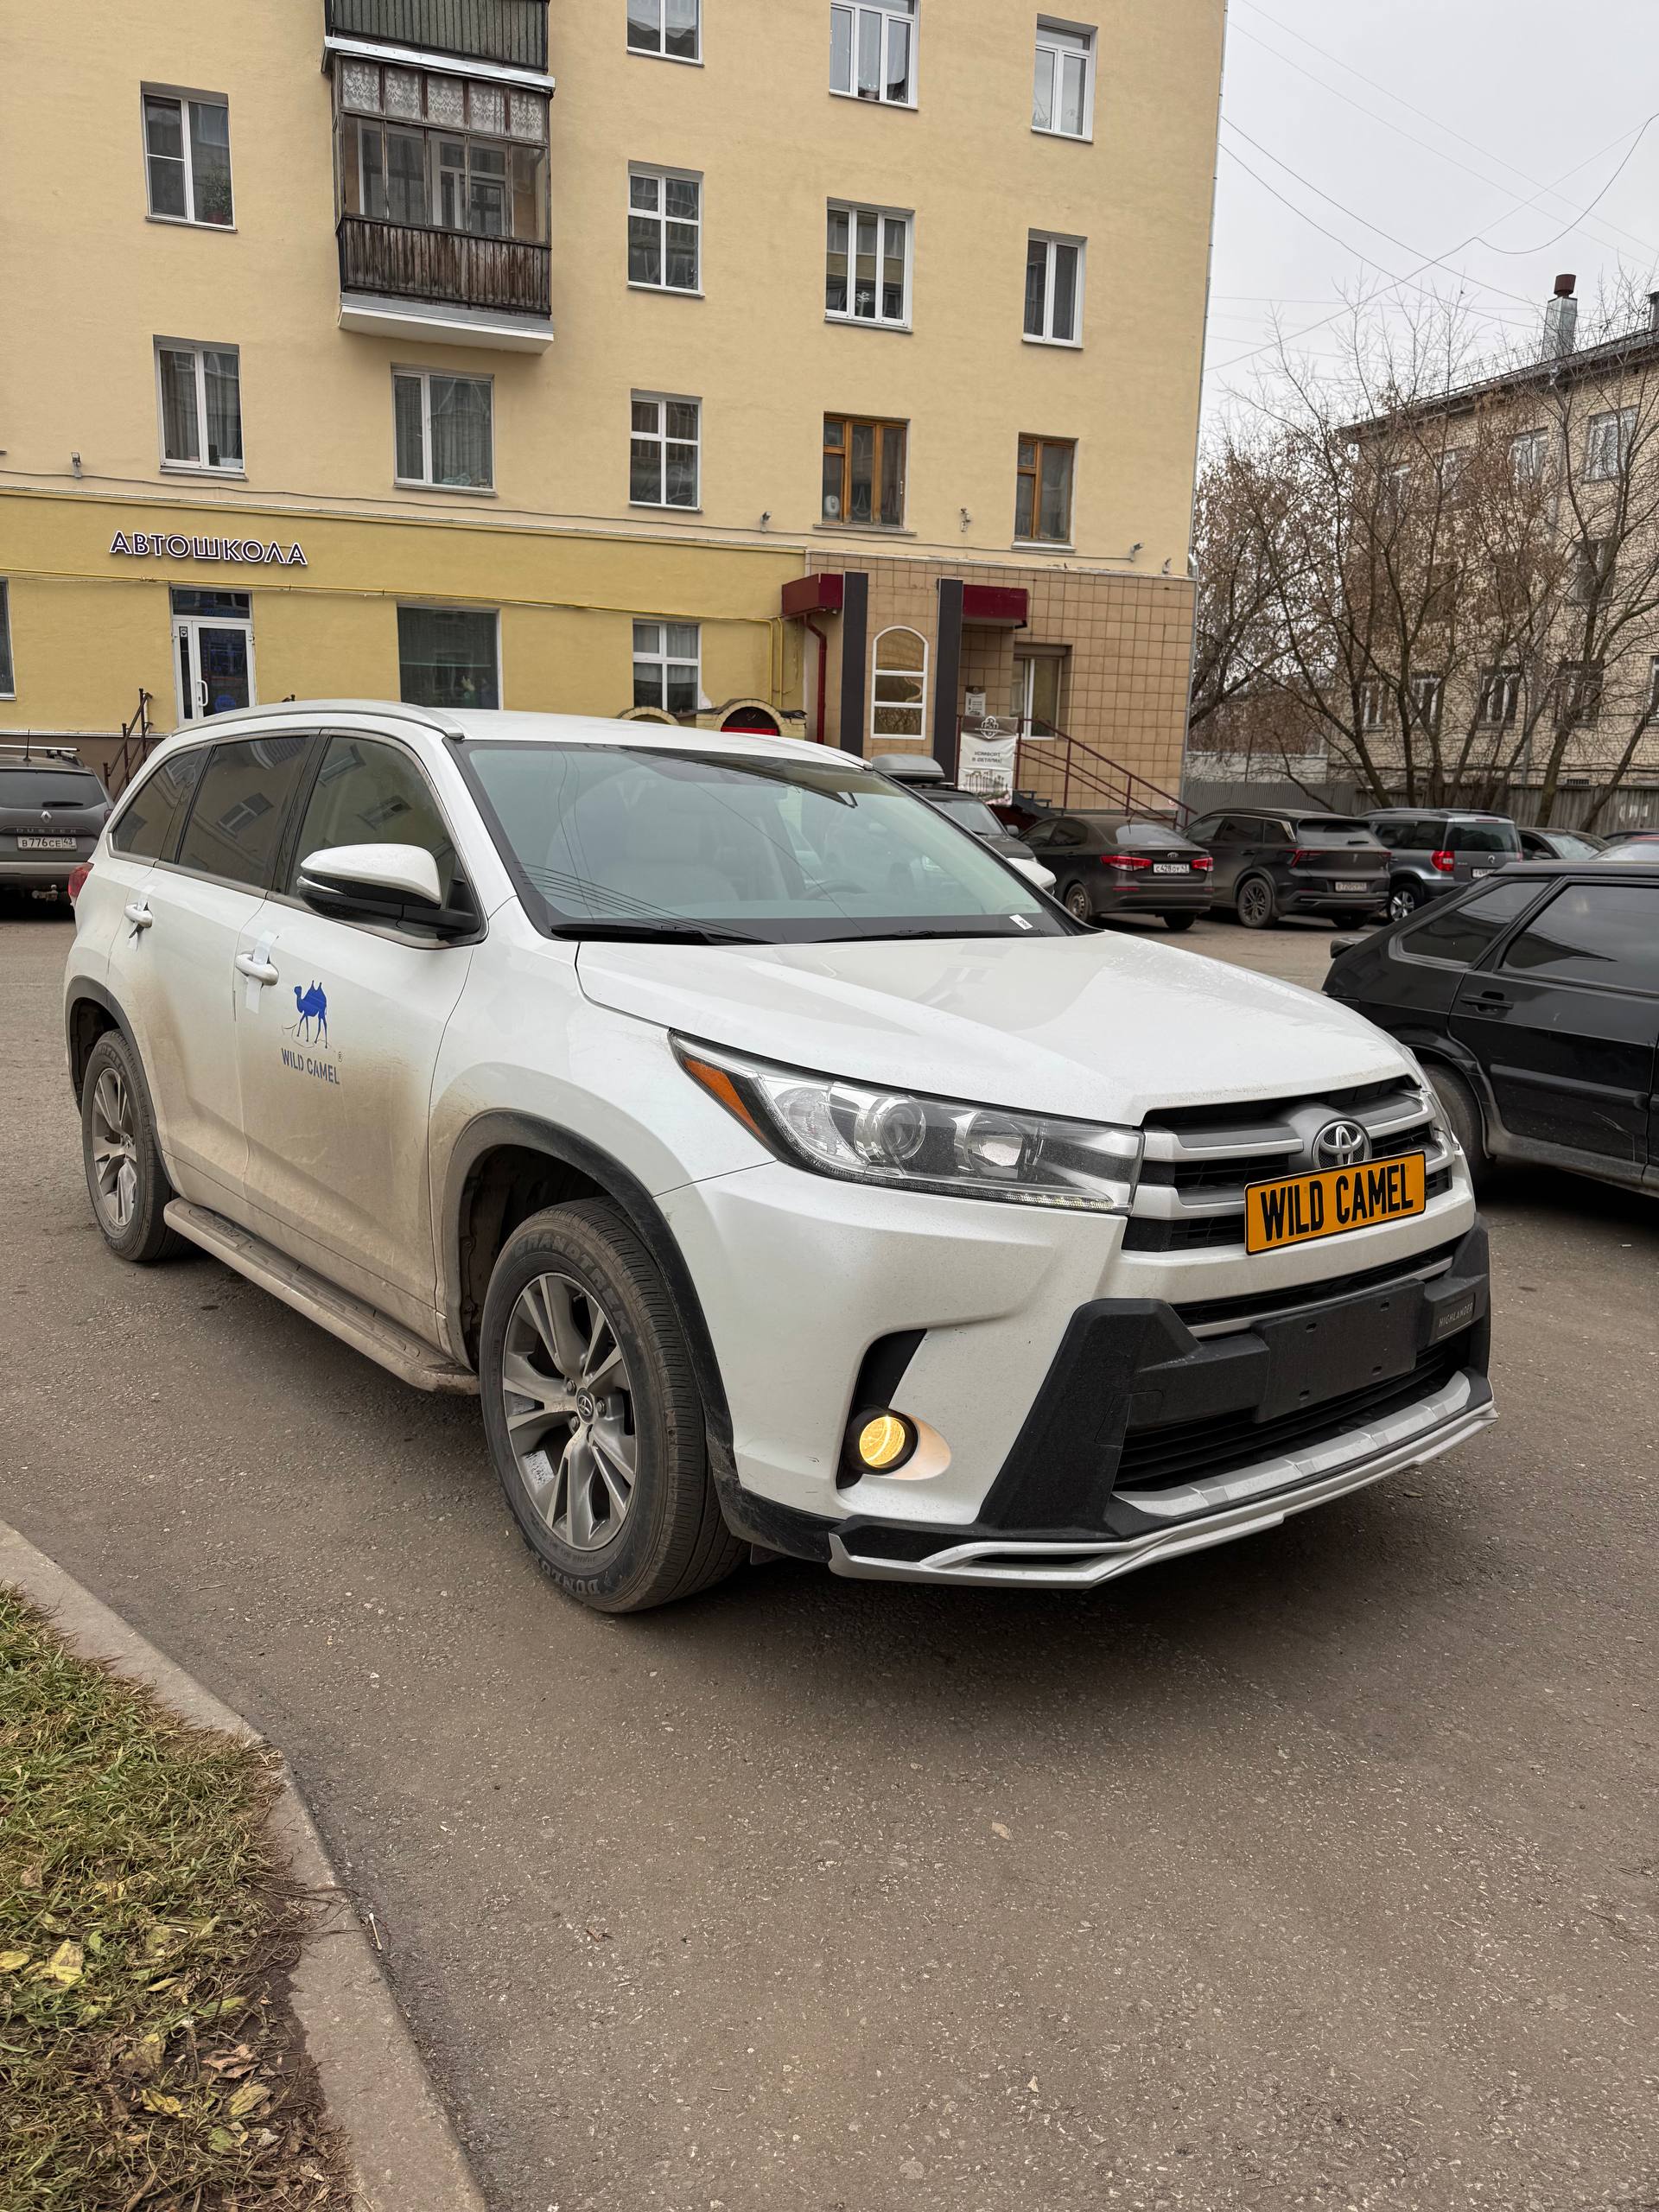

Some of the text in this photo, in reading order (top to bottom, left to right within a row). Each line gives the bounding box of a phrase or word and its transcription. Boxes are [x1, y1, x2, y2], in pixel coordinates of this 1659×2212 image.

[109, 531, 308, 565] АВТОШКОЛА
[281, 1047, 340, 1085] WILD CAMEL
[1260, 1163, 1414, 1242] WILD CAMEL
[1439, 1301, 1473, 1327] HIGHLANDER
